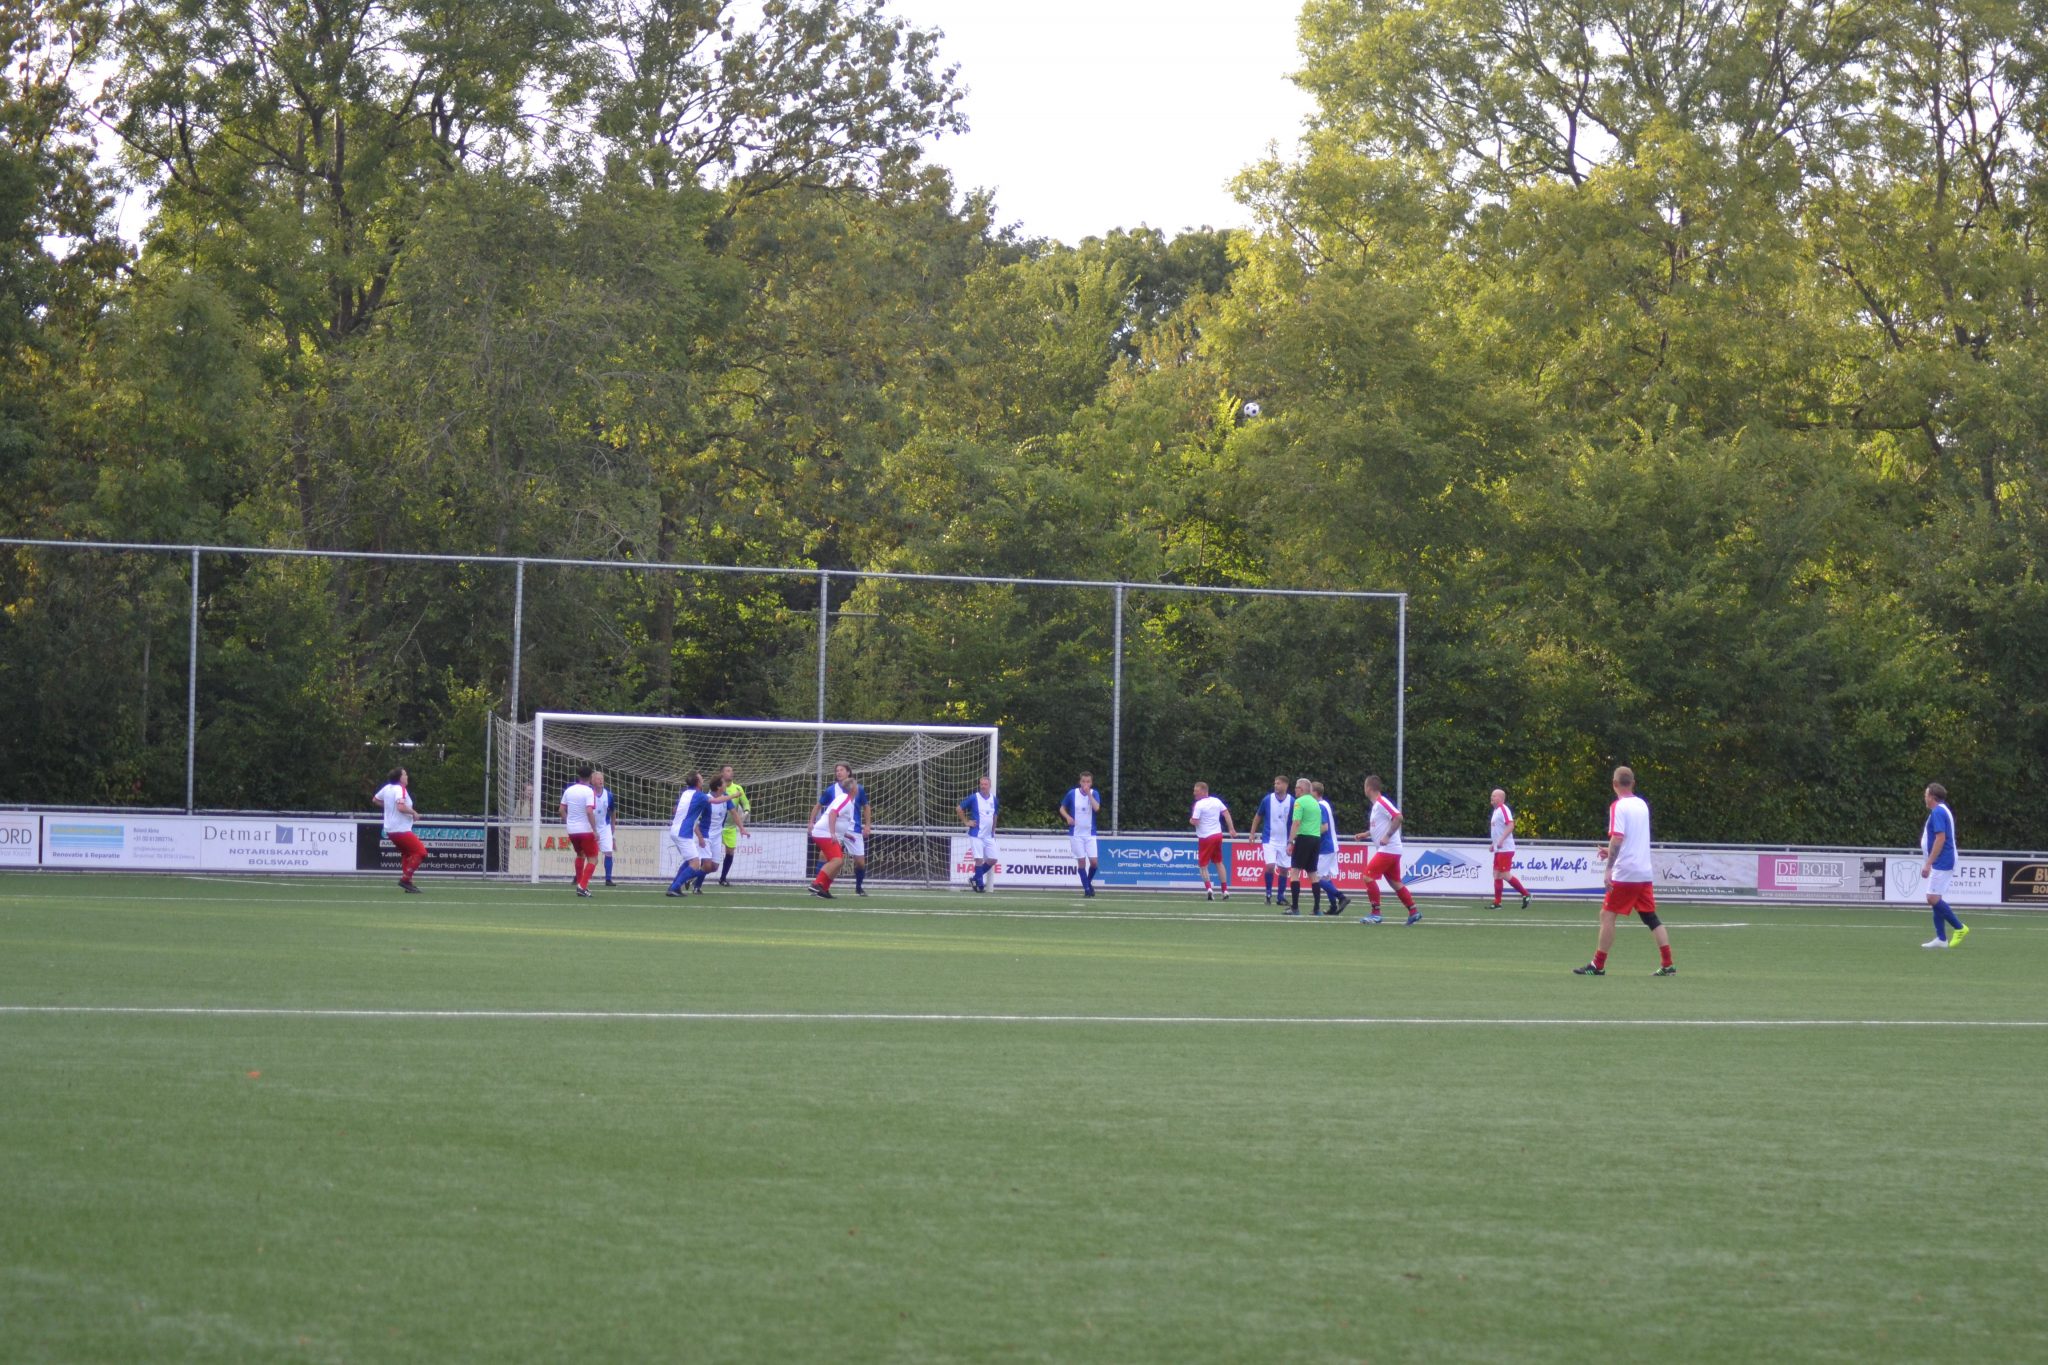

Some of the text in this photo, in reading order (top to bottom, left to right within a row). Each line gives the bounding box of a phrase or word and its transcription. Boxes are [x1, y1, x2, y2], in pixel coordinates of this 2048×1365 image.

[203, 825, 354, 843] Detmar Troost
[52, 851, 83, 859] Renovatie
[90, 852, 121, 860] Reparatie
[229, 848, 328, 856] NOTARISKANTOOR
[248, 858, 309, 866] BOLSWARD
[1510, 861, 1525, 870] an
[1527, 857, 1548, 870] der
[1550, 856, 1588, 873] Werf's
[1006, 864, 1078, 875] ZONWERIN
[1404, 864, 1482, 880] KLOKSLAG
[1662, 867, 1727, 881] Van Buren
[1777, 862, 1839, 876] DE BOER
[1347, 870, 1362, 880] hier
[1520, 874, 1555, 882] Bouwstoffen
